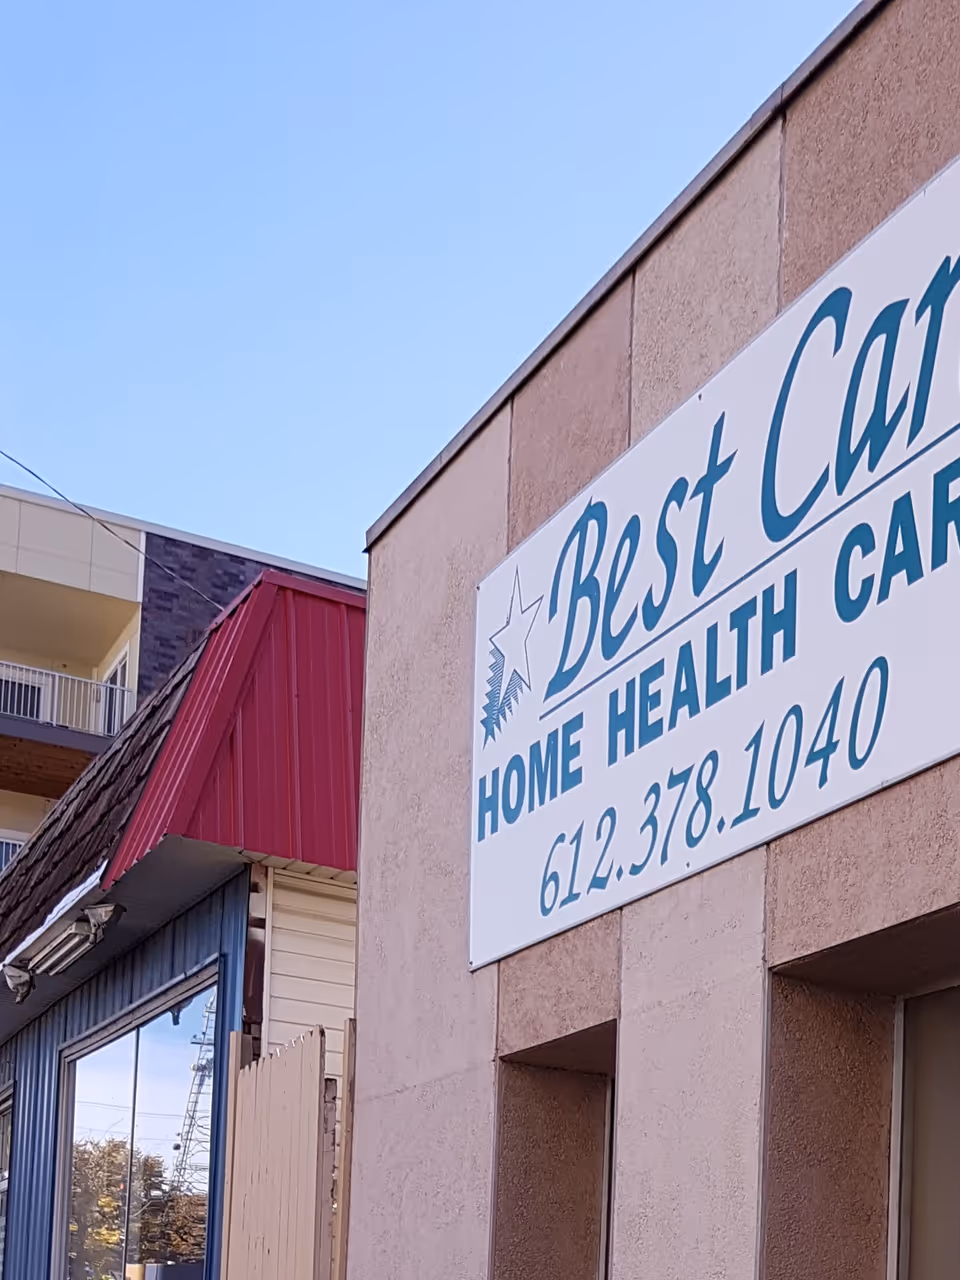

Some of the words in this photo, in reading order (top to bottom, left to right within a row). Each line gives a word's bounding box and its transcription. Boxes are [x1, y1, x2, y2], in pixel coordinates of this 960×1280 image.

[543, 411, 738, 702] Best
[477, 712, 584, 842] HOME
[607, 569, 798, 766] HEALTH
[540, 655, 889, 917] 612.378.1040
